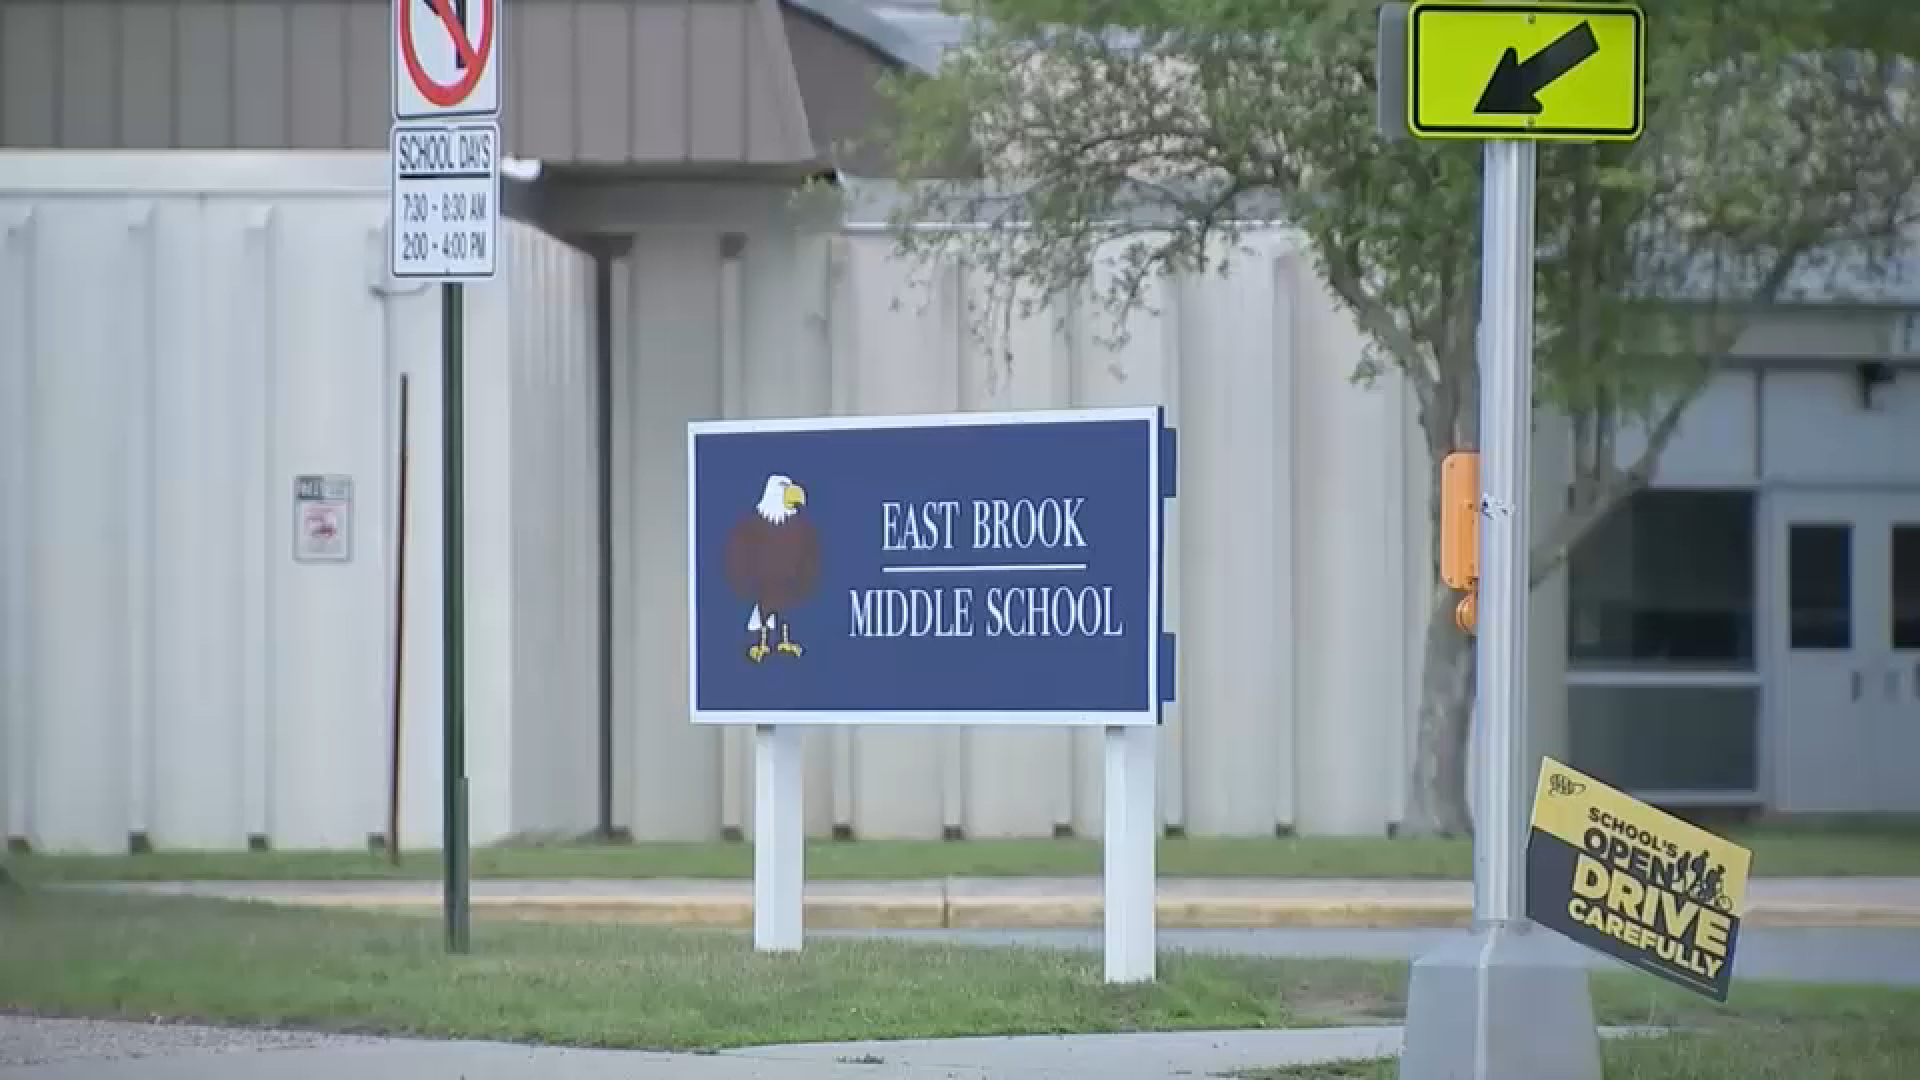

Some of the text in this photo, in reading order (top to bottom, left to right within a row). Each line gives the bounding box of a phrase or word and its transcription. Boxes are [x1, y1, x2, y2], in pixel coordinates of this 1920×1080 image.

[400, 133, 491, 170] SCHOOL DAYS
[403, 192, 428, 221] 7:30
[442, 192, 466, 221] 8:30
[470, 192, 487, 221] AM
[402, 232, 428, 260] 2:00
[442, 232, 466, 259] 4:00
[470, 232, 487, 259] PM
[882, 497, 1087, 551] EAST BROOK
[849, 586, 1123, 637] MIDDLE SCHOOL
[1584, 827, 1673, 889] OPEN
[1588, 806, 1678, 858] SCHOOL'S
[1572, 852, 1731, 957] DRIVE
[1568, 897, 1723, 979] CAREFULLY
